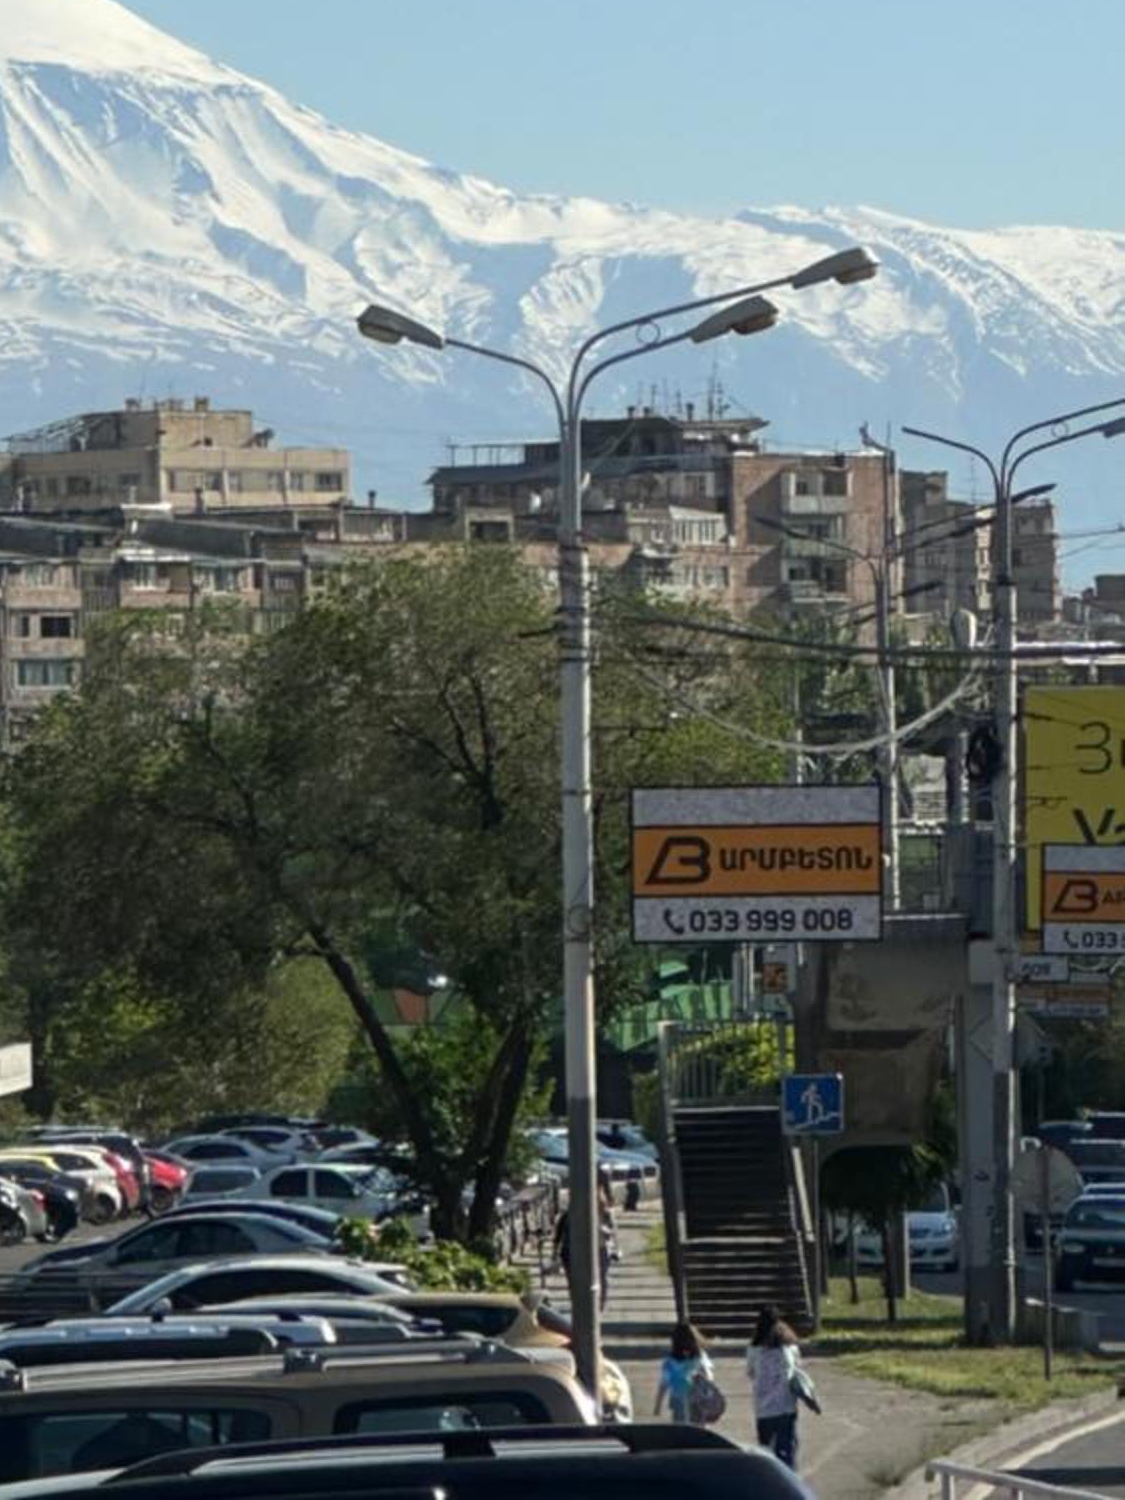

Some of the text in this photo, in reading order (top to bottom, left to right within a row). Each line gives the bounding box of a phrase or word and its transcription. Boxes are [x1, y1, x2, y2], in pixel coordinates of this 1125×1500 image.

[689, 908, 853, 933] 033 999 008
[1081, 931, 1118, 949] 033
